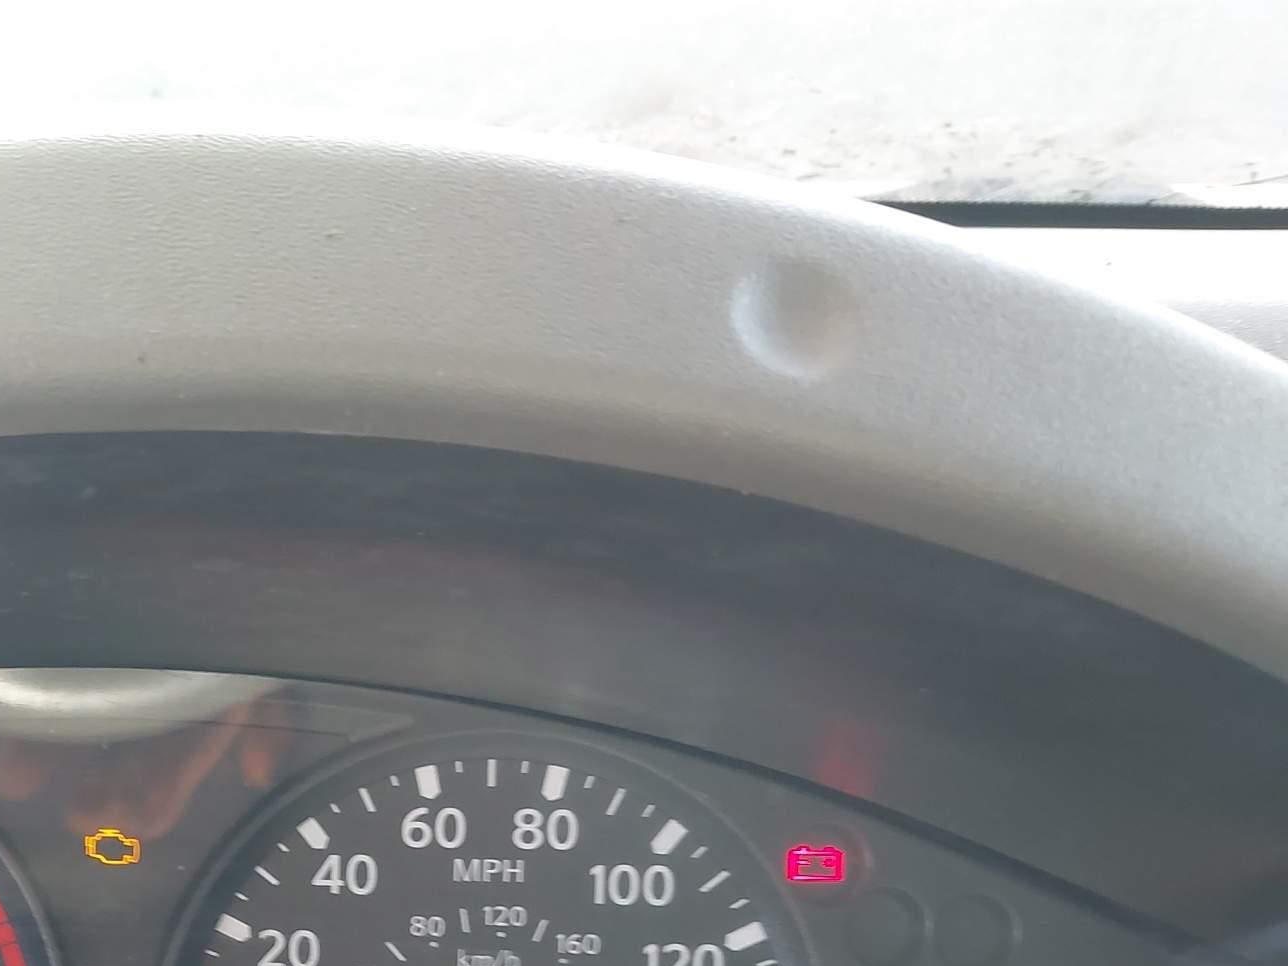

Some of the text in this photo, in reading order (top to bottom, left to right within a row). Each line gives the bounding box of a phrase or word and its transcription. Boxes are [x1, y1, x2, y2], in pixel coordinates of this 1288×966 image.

[400, 806, 467, 850] 60
[512, 807, 579, 851] 80
[311, 853, 378, 896] 40
[452, 858, 526, 884] MPH
[589, 863, 675, 907] 100
[409, 914, 446, 938] 80
[482, 905, 528, 929] 120
[555, 932, 601, 957] 160
